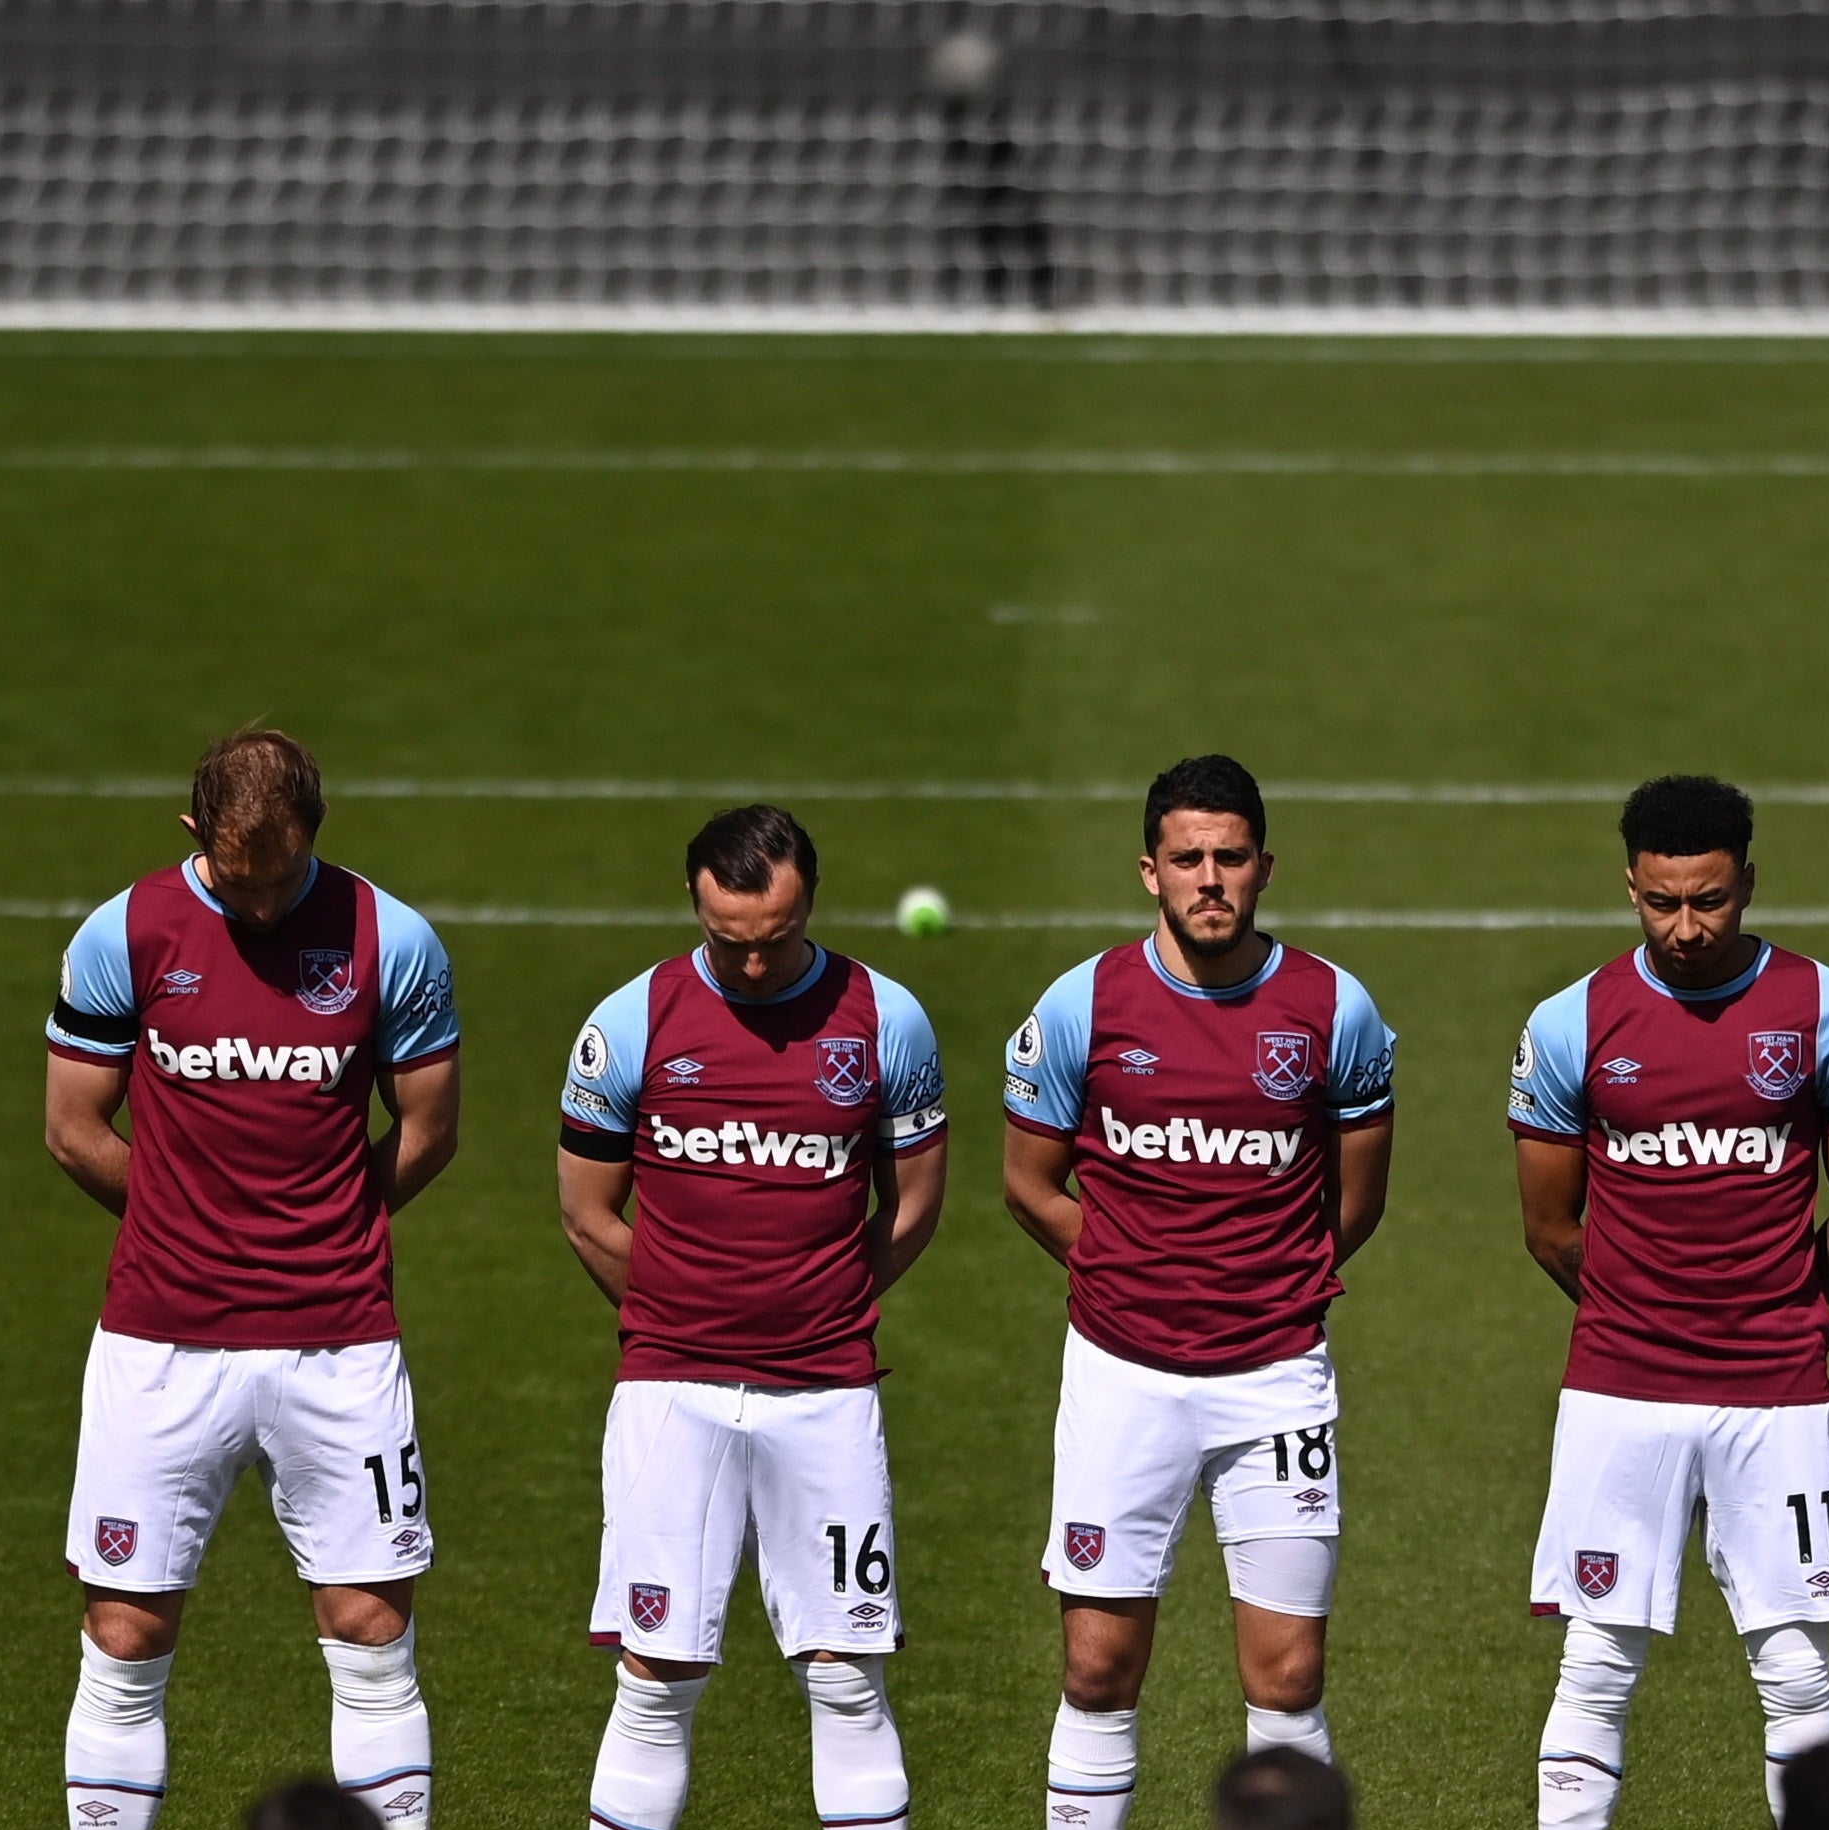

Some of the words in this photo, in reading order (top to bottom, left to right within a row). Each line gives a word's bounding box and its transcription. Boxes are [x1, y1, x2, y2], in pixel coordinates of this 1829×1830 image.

[167, 986, 199, 994] umbro
[148, 1029, 357, 1091] betway
[667, 1076, 700, 1084] umbro
[1606, 1076, 1637, 1084] umbro
[651, 1115, 862, 1179] betway
[1101, 1107, 1304, 1176] betway
[1600, 1119, 1793, 1174] betway
[363, 1441, 422, 1523] 15
[1272, 1424, 1331, 1481] 18
[825, 1522, 890, 1594] 16
